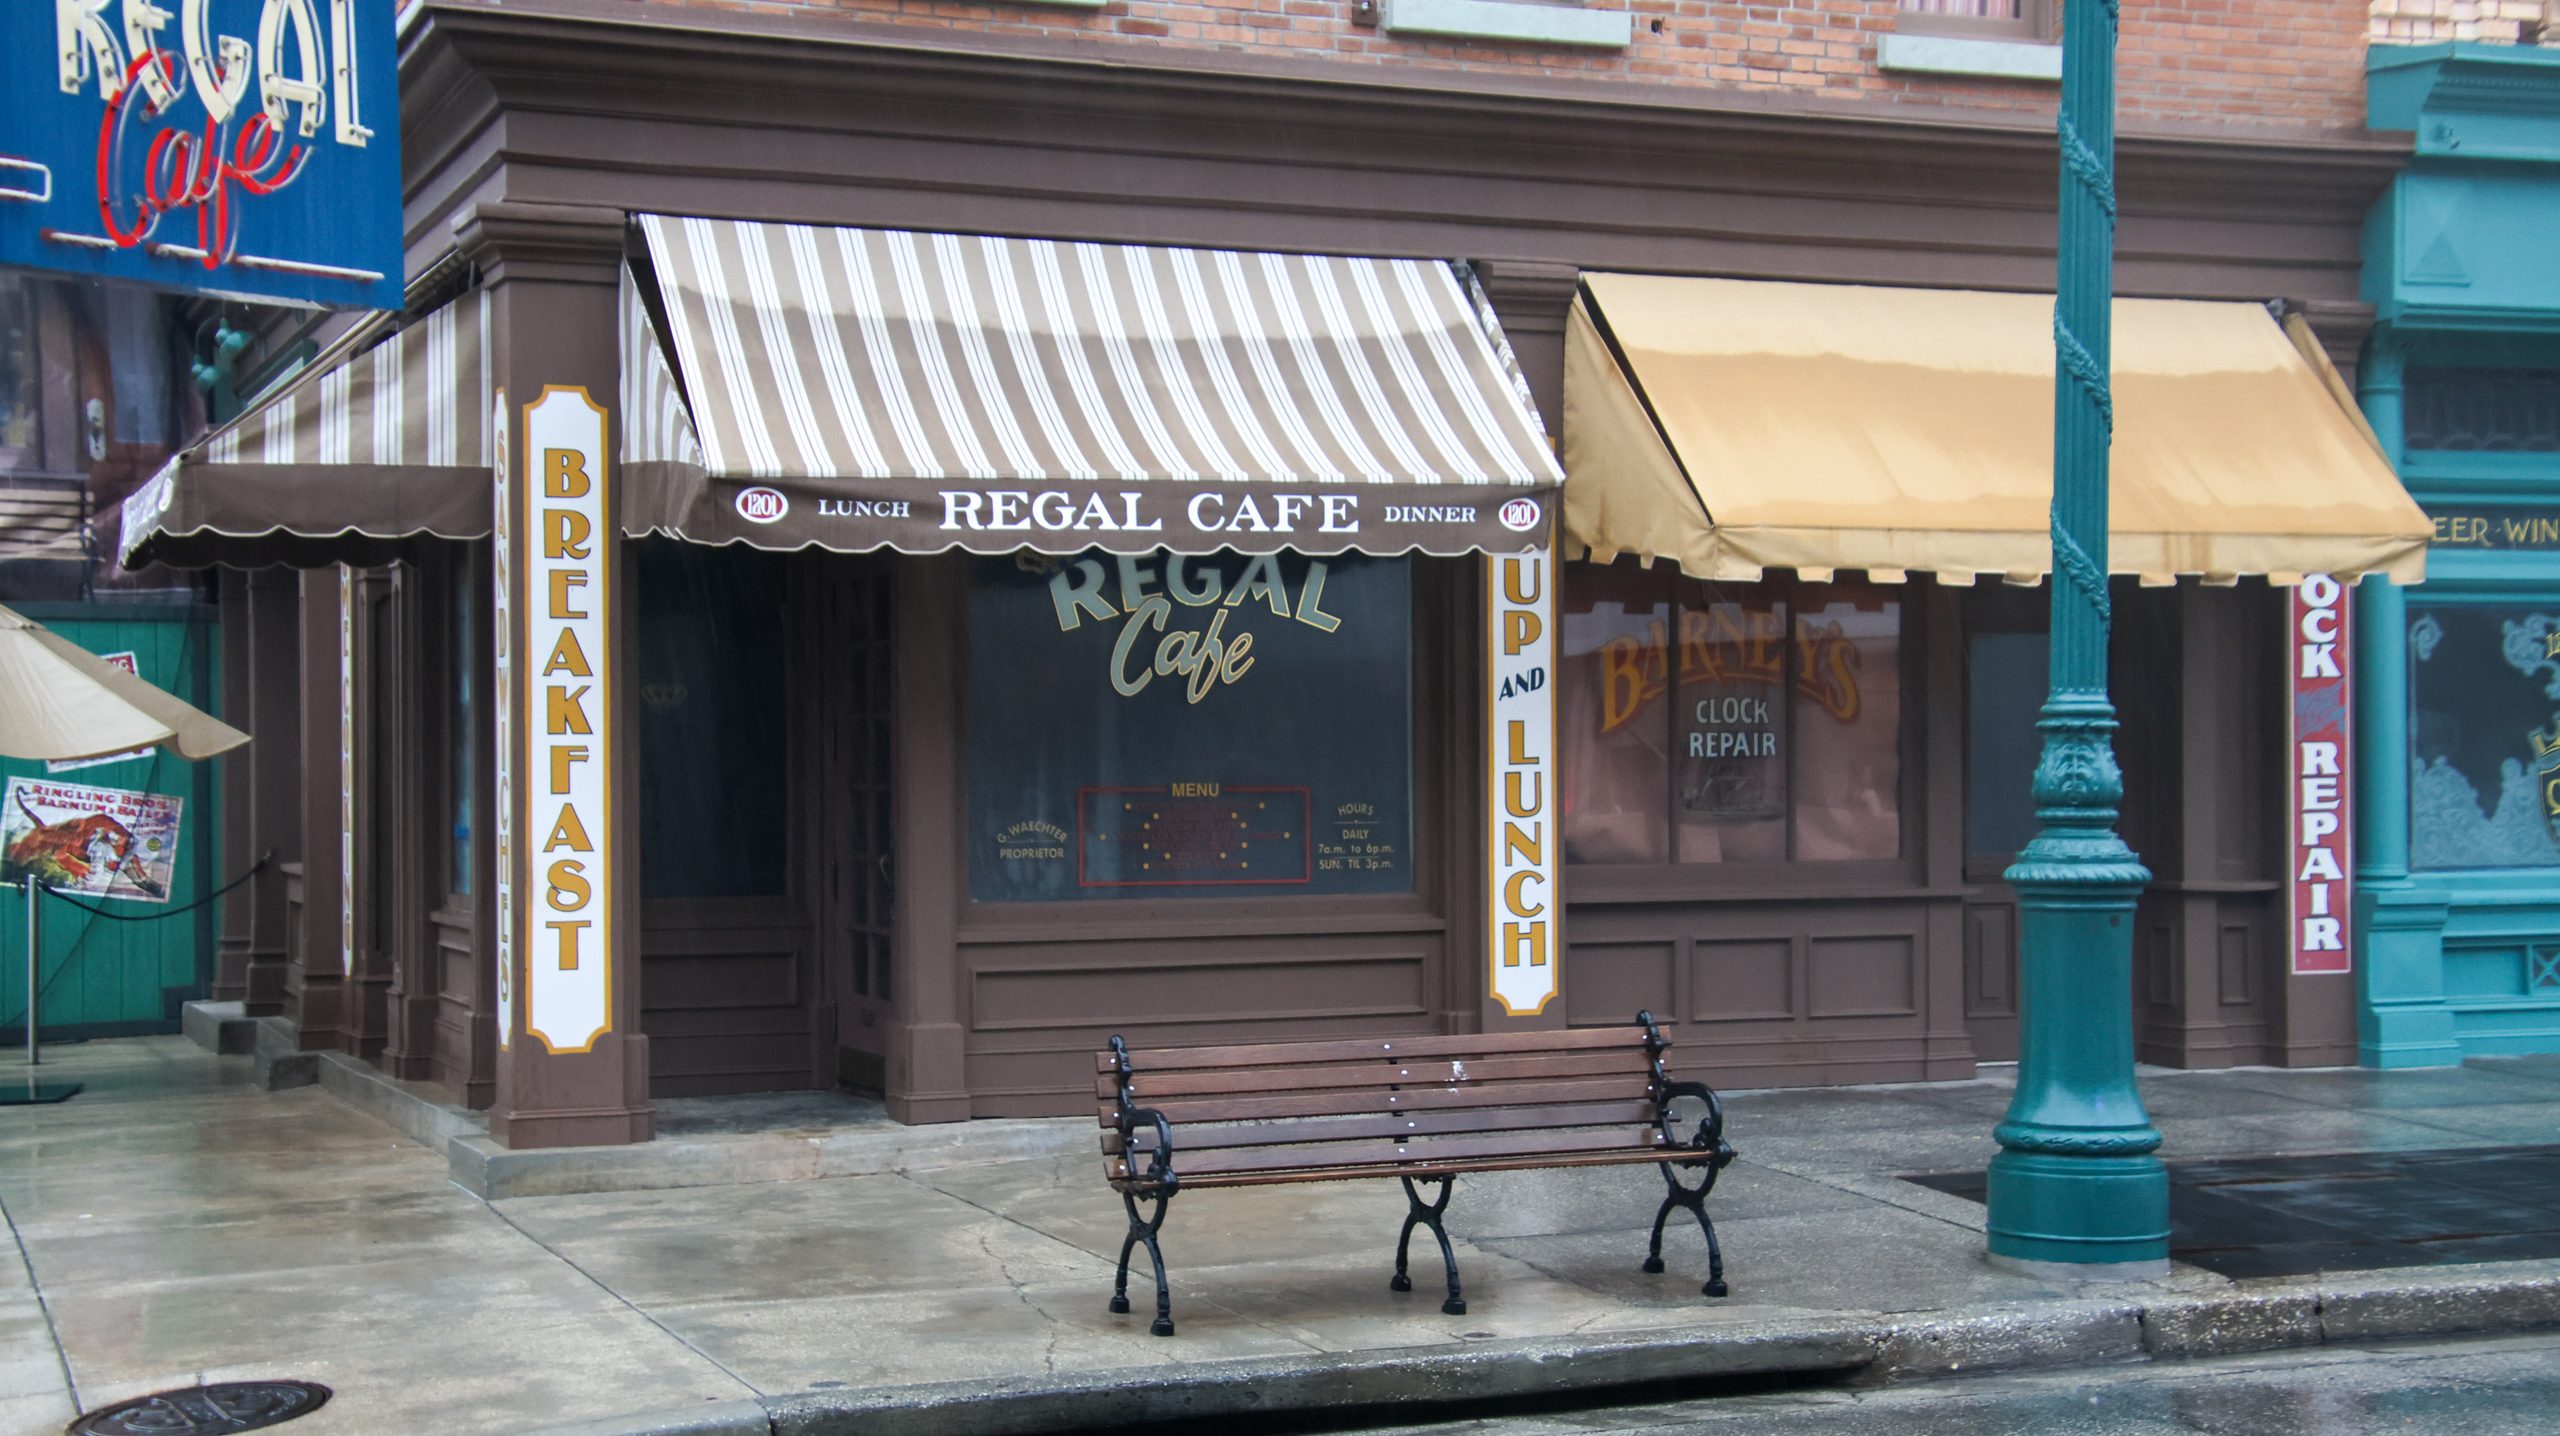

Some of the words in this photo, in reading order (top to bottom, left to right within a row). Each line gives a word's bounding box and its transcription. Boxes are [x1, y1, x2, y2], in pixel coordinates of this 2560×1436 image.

[55, 0, 375, 148] REGAL
[97, 48, 316, 270] Cafe
[747, 493, 777, 516] 1201
[818, 499, 911, 518] LUNCH
[938, 491, 1162, 531] REGAL
[1187, 493, 1360, 533] CAFE
[1384, 506, 1477, 523] DINNER
[1507, 504, 1531, 524] 1201
[2432, 517, 2495, 548] EER
[2503, 517, 2560, 543] WIN
[1049, 553, 1342, 633] REGAL
[1503, 558, 1543, 655] UP
[2300, 573, 2343, 679] OCK
[1110, 596, 1255, 704] Cafe
[1499, 666, 1545, 702] AND
[496, 429, 509, 1003] SANDWICHES
[543, 448, 595, 971] BREAKFAST
[1696, 697, 1769, 725] CLOCK
[1689, 732, 1777, 758] REPAIR
[32, 784, 116, 803] RINGLING
[1171, 783, 1220, 798] MENU
[1337, 803, 1374, 816] HOURS
[999, 847, 1065, 860] PROPRIETOR
[1342, 829, 1370, 840] DAILY
[1351, 844, 1362, 854] to
[1503, 720, 1547, 968] LUNCH
[2299, 741, 2345, 951] REPAIR
[1348, 859, 1361, 870] TIL
